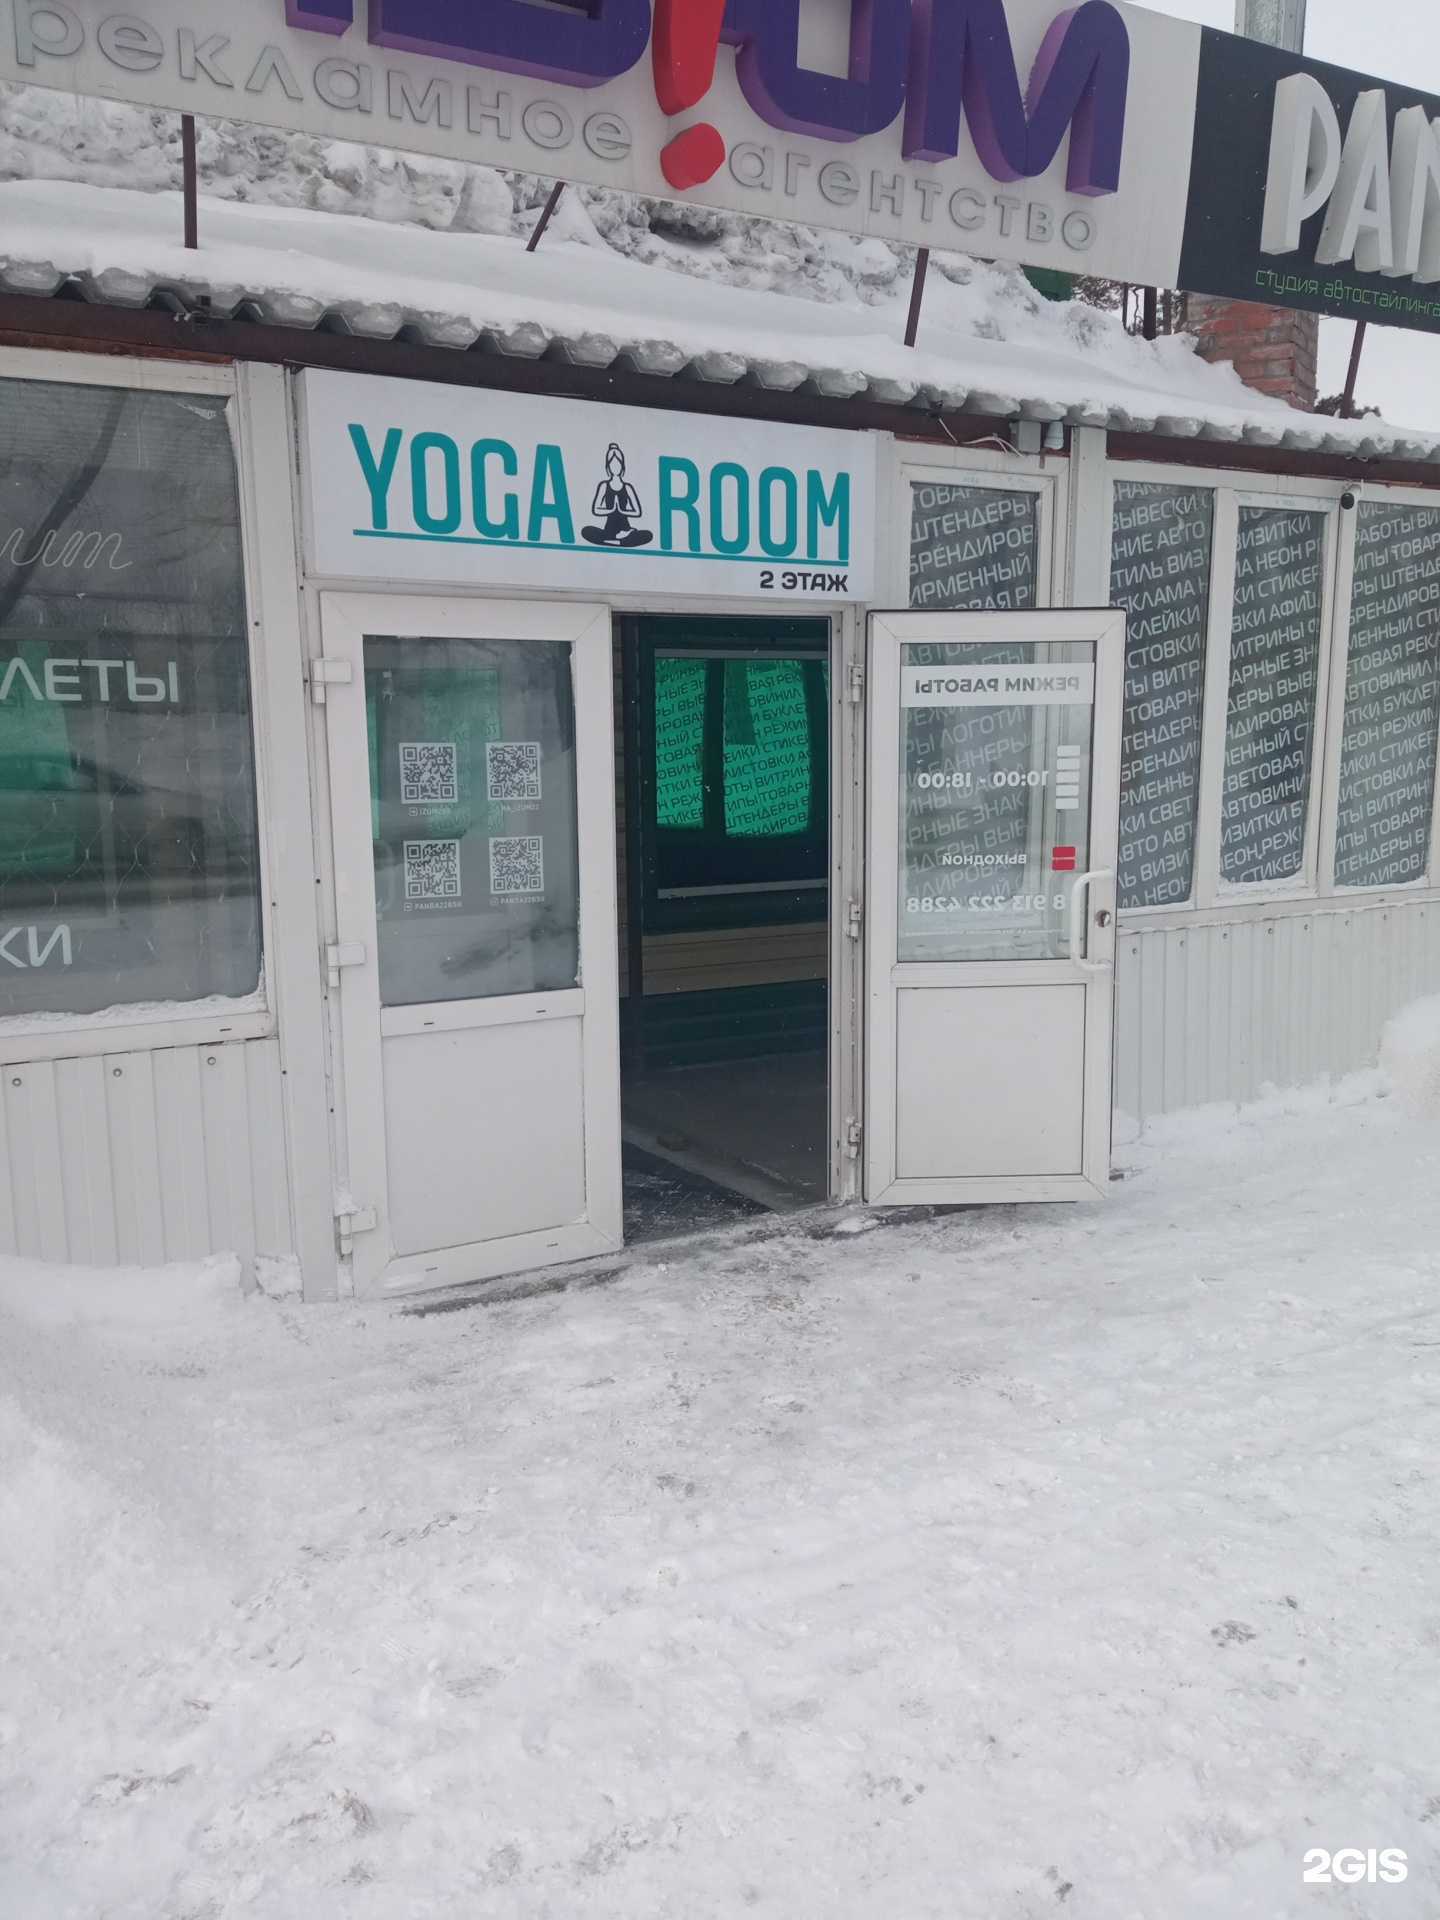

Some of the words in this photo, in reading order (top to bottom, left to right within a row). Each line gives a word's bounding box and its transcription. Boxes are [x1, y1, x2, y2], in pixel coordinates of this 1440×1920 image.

[11, 0, 633, 161] рекламное
[727, 139, 1097, 253] агентство
[1254, 268, 1319, 296] студия
[347, 423, 576, 545] YOGA
[657, 454, 851, 561] ROOM
[1110, 534, 1154, 561] НИЕ
[1157, 520, 1206, 550] АВТО
[1255, 543, 1302, 572] НЕОН
[759, 570, 775, 589] 2
[780, 571, 849, 593] ЭТАЖ
[1111, 560, 1163, 590] ТИЛЬ
[1223, 749, 1304, 795] ВЕТОВАЯ
[1221, 842, 1259, 873] ЕОН
